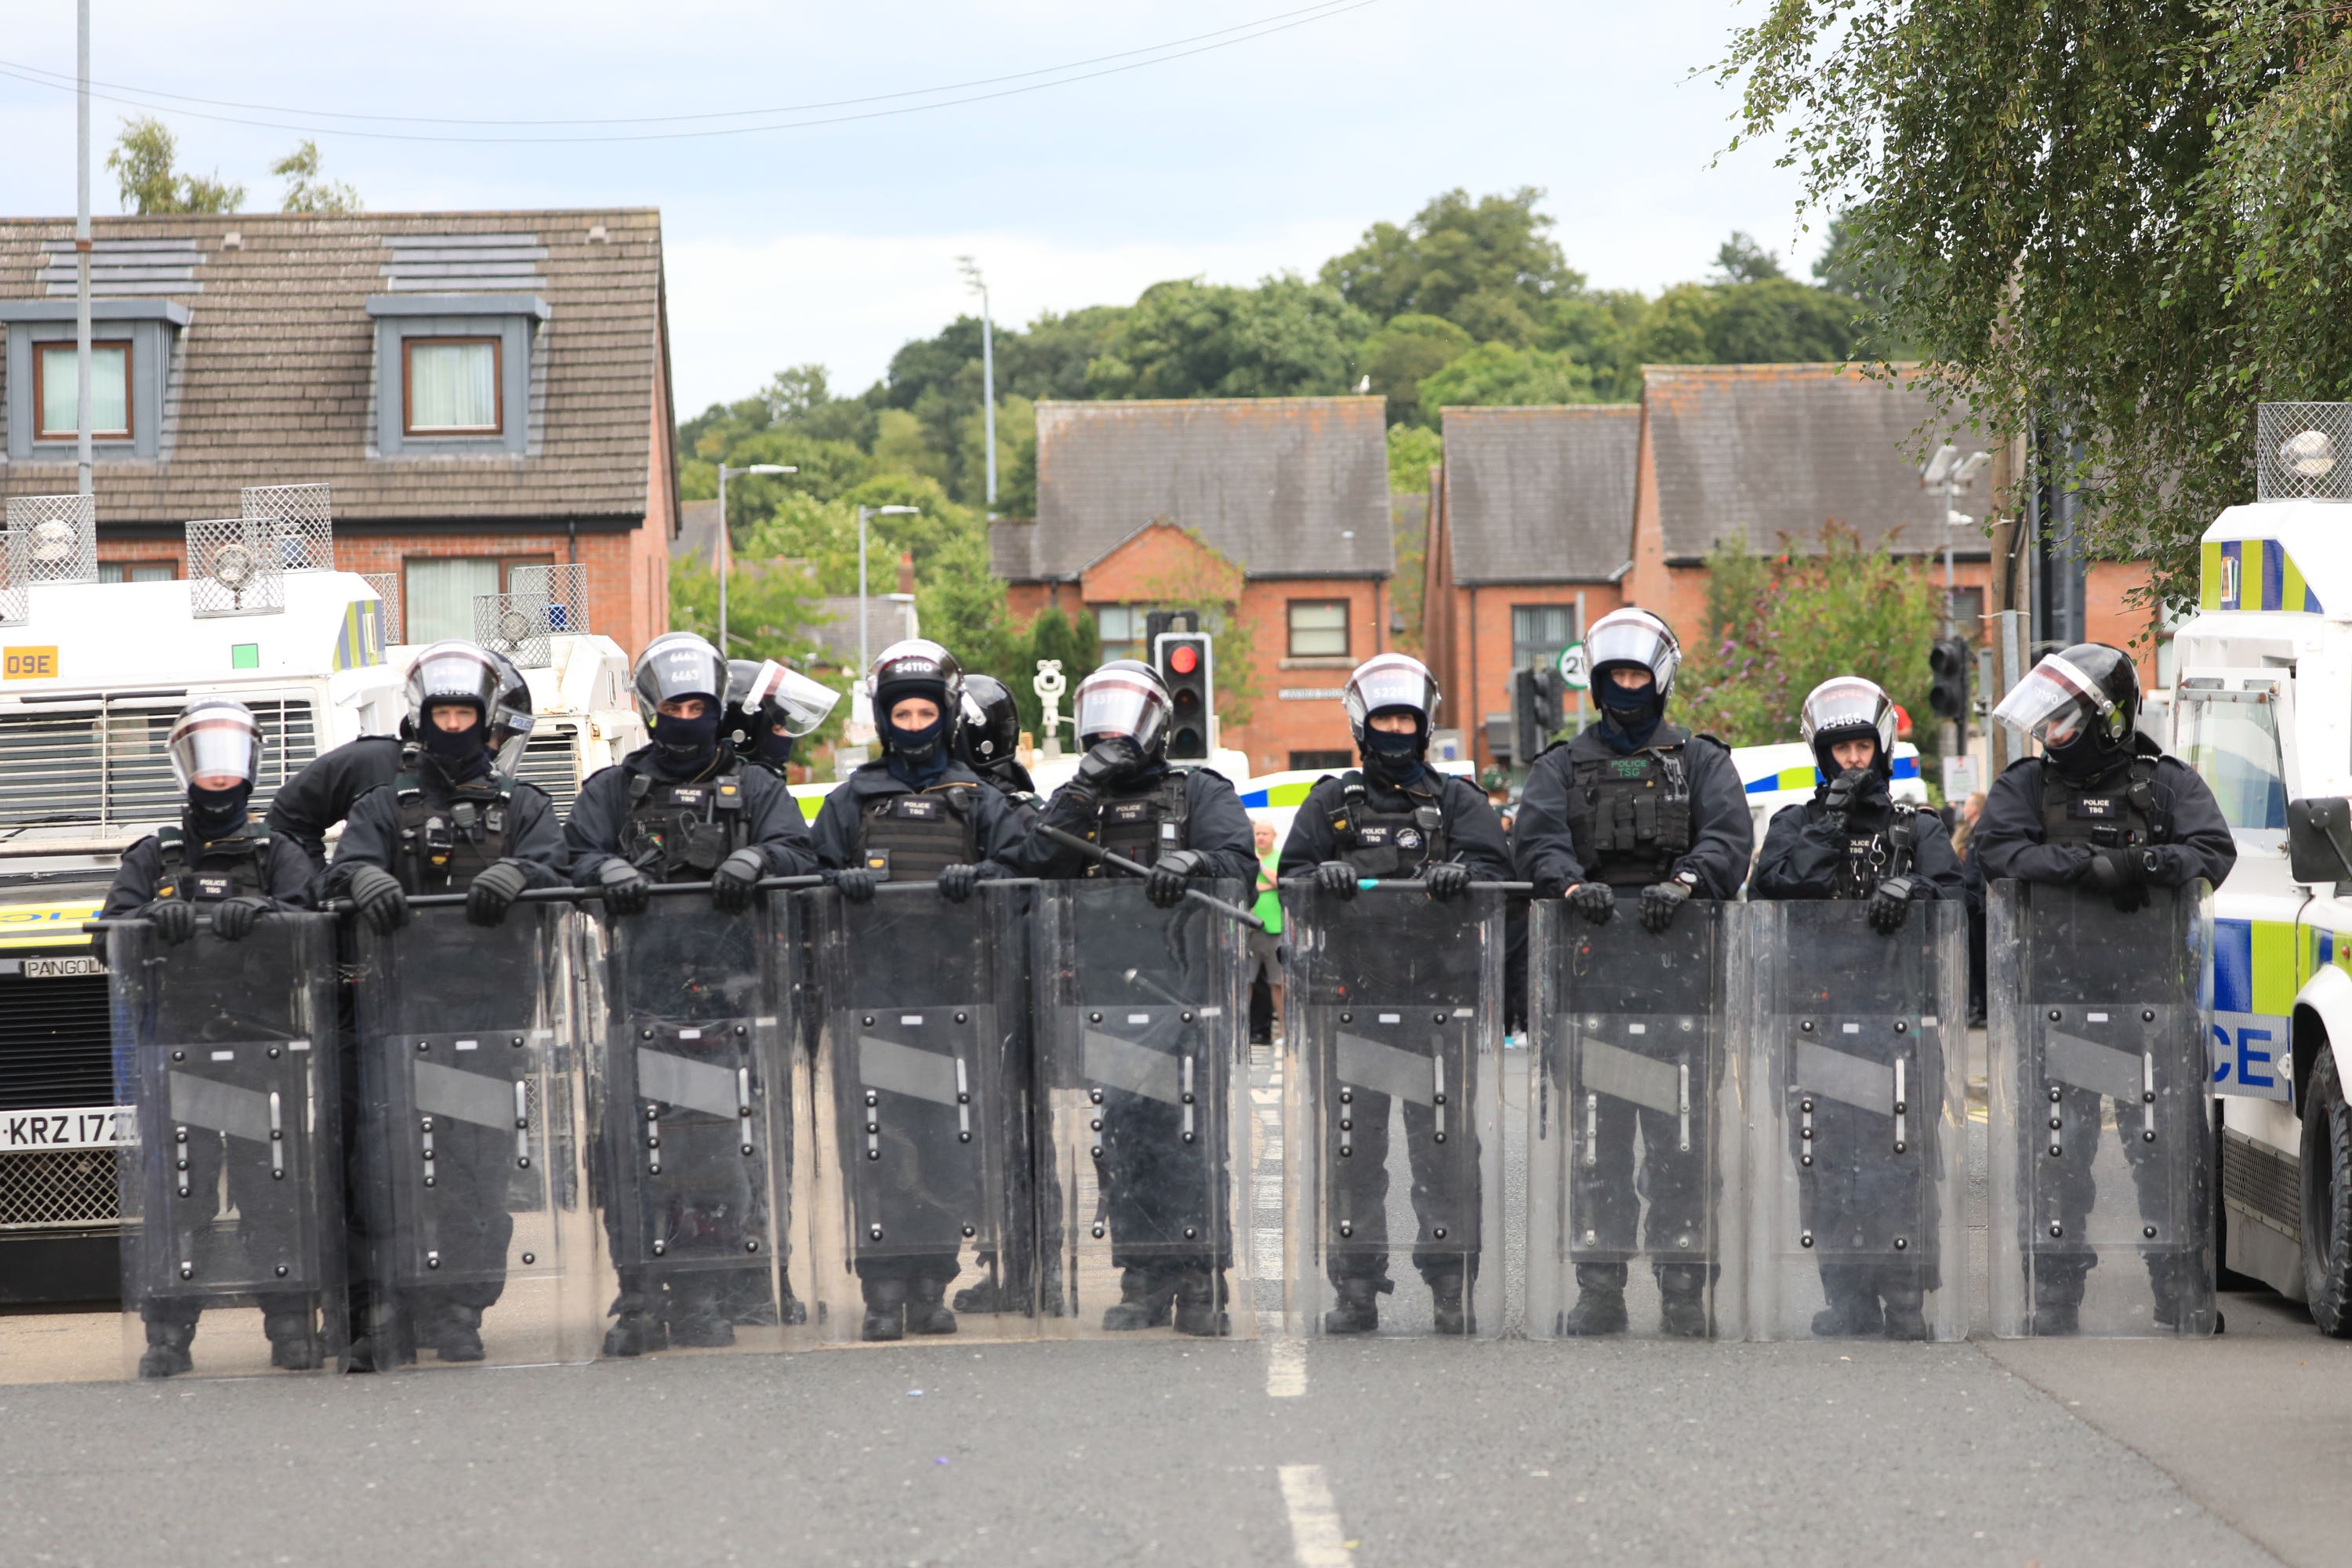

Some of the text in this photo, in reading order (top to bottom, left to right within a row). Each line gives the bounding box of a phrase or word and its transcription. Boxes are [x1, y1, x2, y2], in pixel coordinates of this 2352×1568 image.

[7, 655, 51, 674] 09E
[895, 662, 933, 673] 54110
[1611, 760, 1646, 768] POLICE
[1617, 768, 1640, 777] TSG
[9, 1112, 136, 1145] KRZ 172
